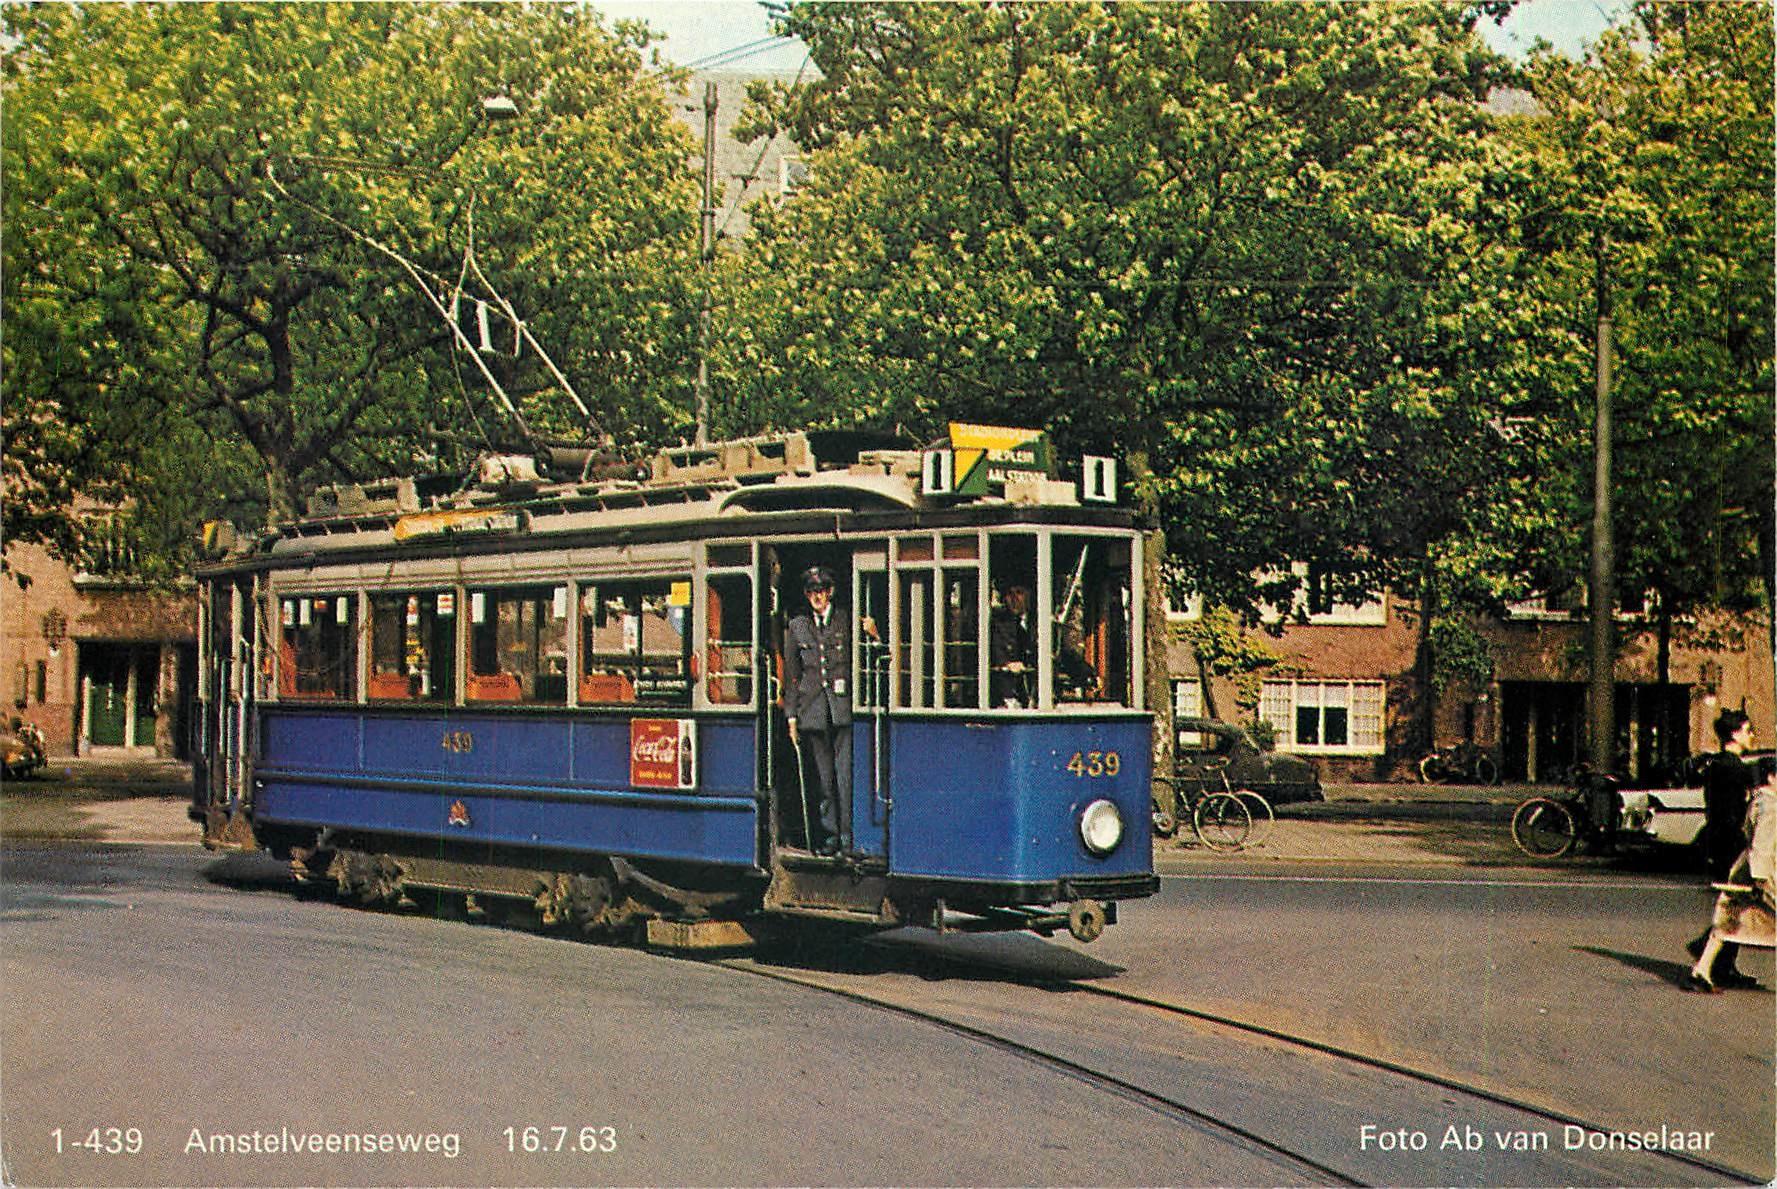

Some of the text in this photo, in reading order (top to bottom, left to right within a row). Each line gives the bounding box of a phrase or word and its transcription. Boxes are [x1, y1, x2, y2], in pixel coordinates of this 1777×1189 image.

[1094, 459, 1106, 496] 1
[441, 731, 472, 752] 439
[1065, 751, 1121, 777] 439
